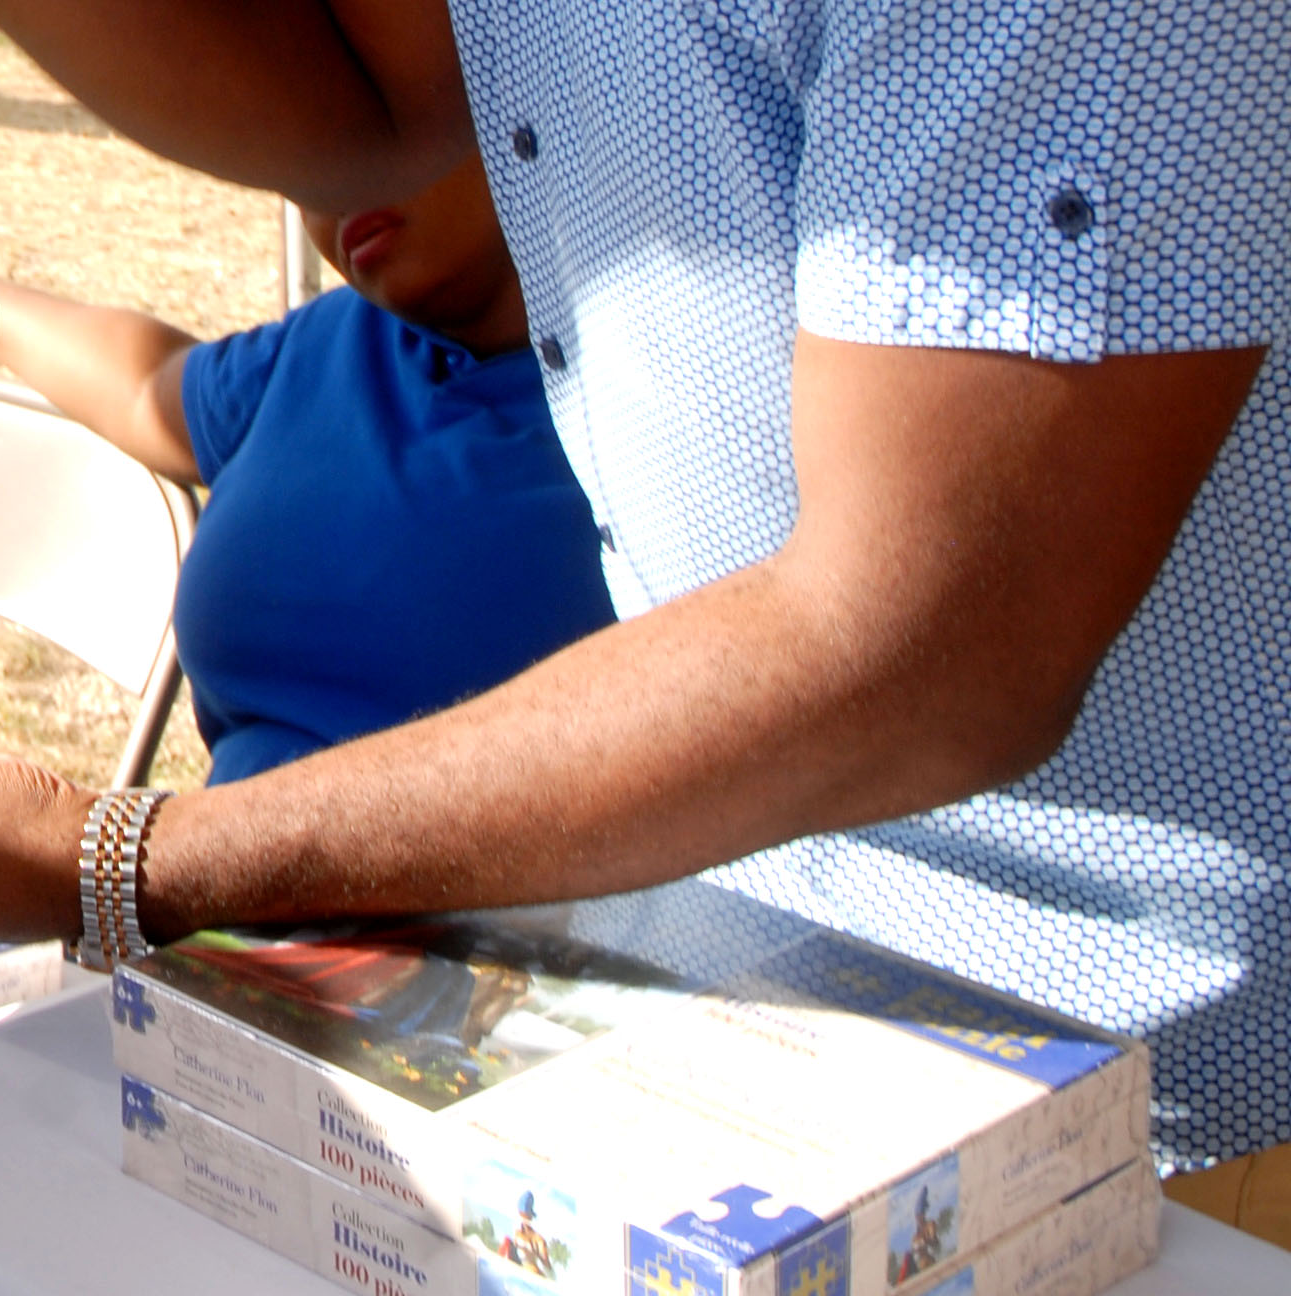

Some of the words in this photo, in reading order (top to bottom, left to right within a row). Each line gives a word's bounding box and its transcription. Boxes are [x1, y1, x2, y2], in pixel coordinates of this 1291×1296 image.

[173, 1044, 234, 1088] Catherine
[236, 1075, 266, 1105] Flon
[317, 1088, 389, 1140] Collection
[319, 1108, 410, 1172] Histoire
[183, 1153, 245, 1197] Catherine
[248, 1185, 279, 1215] Flon
[320, 1139, 355, 1174] 100
[359, 1164, 425, 1209] pièces
[331, 1202, 405, 1252] Collection
[333, 1219, 428, 1286] Histoire
[333, 1251, 370, 1286] 100
